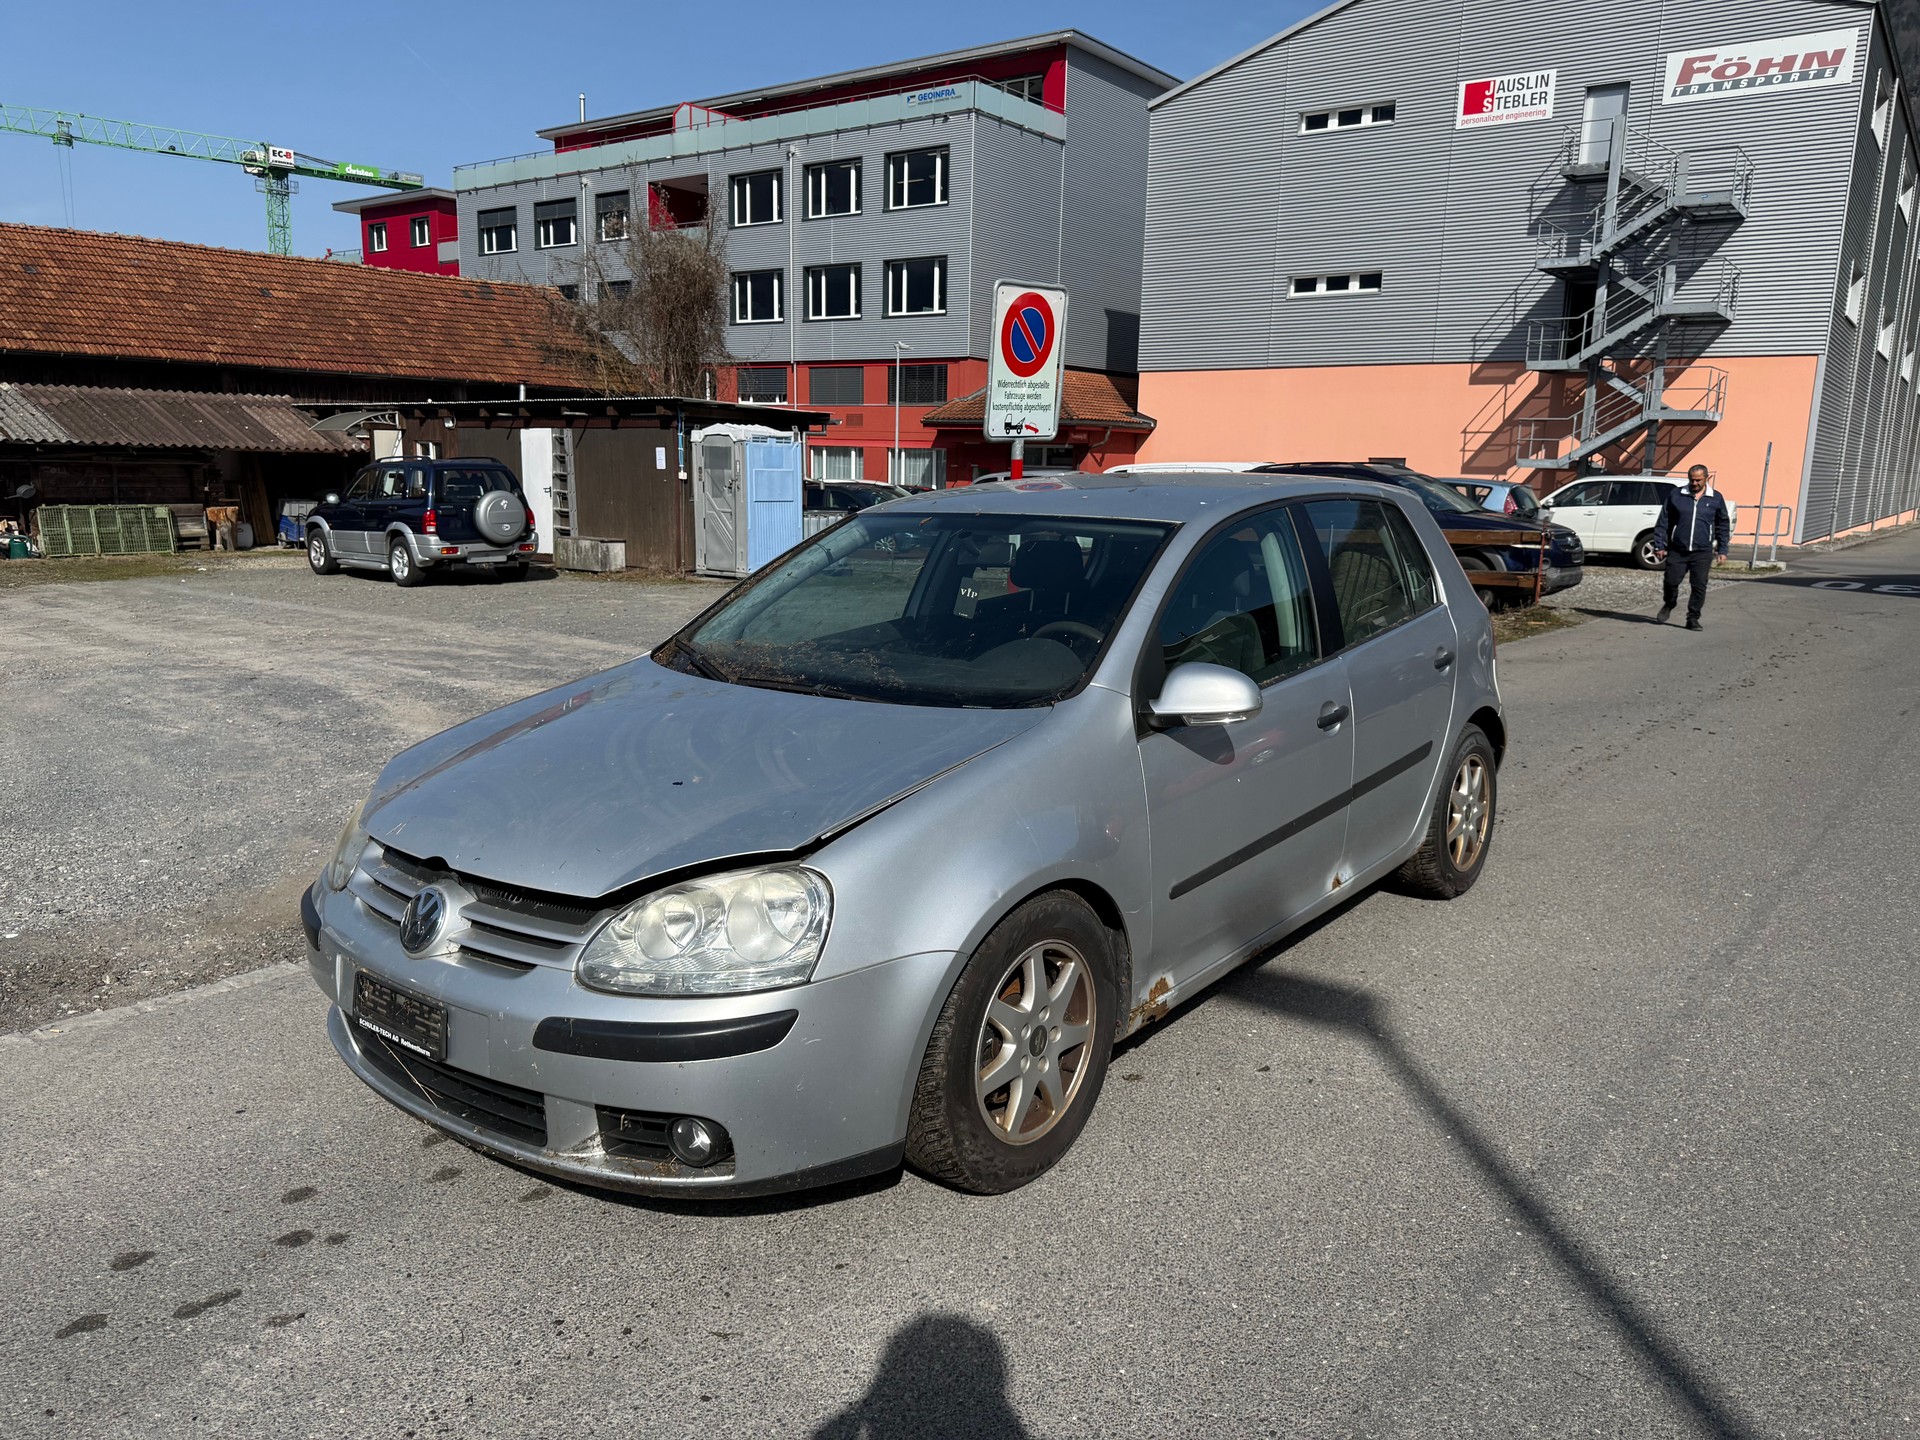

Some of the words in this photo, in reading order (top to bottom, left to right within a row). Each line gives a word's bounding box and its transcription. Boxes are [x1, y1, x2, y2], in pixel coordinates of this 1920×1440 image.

[1675, 48, 1847, 86] FÖHN
[1484, 74, 1550, 96] JAUSLIN
[1675, 67, 1835, 96] TRANSPORTE
[917, 88, 956, 102] GEOINFRA
[1482, 91, 1548, 113] STEBLER
[1461, 113, 1504, 127] personalized
[1505, 109, 1547, 120] engineering
[272, 150, 292, 160] EC-B
[997, 379, 1027, 389] Widerrechtlich
[1027, 380, 1050, 391] abgestellte
[1004, 391, 1026, 402] Fahrzeuge
[1026, 392, 1042, 400] werden
[992, 402, 1023, 413] kostenpflichtig
[960, 587, 978, 598] VIP
[359, 1018, 392, 1040] SCHULER-TECH
[400, 1038, 431, 1057] Rothenthurm
